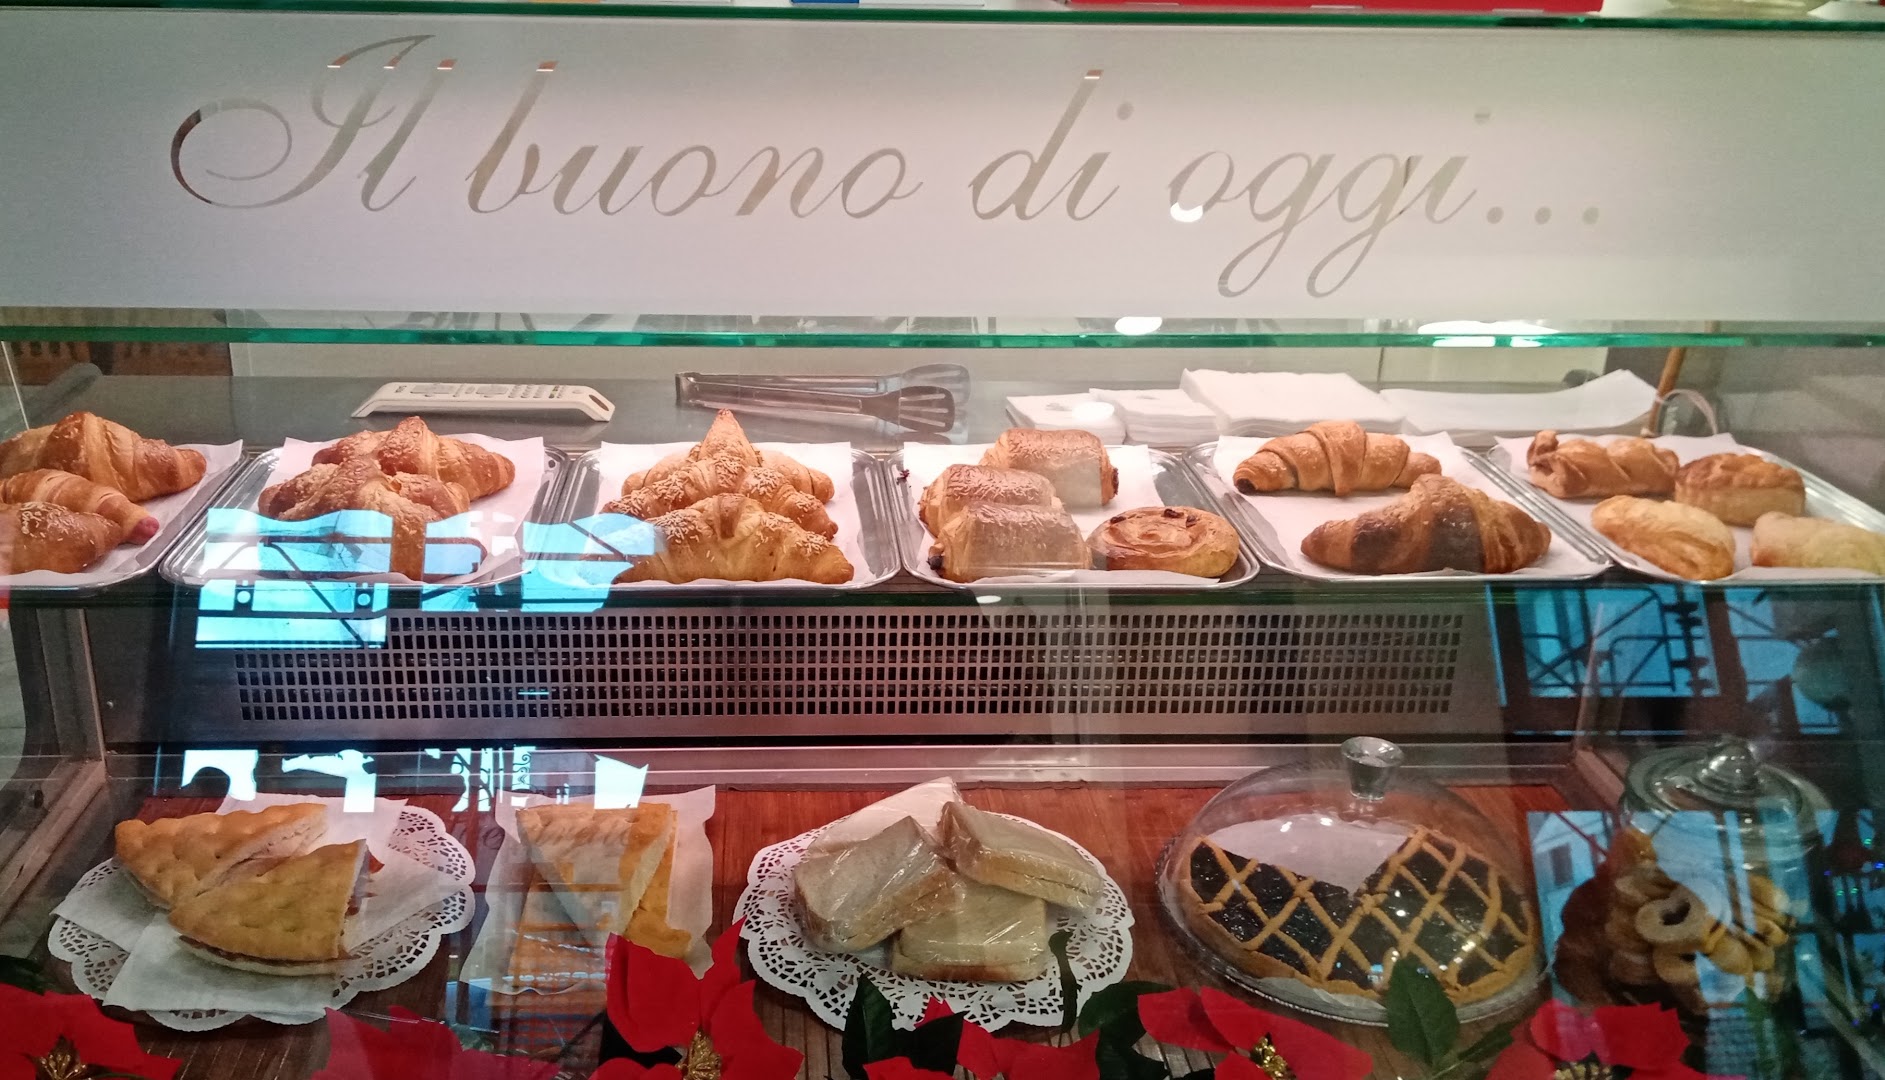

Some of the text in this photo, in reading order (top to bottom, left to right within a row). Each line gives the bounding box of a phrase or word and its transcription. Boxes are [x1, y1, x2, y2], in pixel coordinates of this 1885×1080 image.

[170, 34, 1602, 298] Il buono di oggi...
